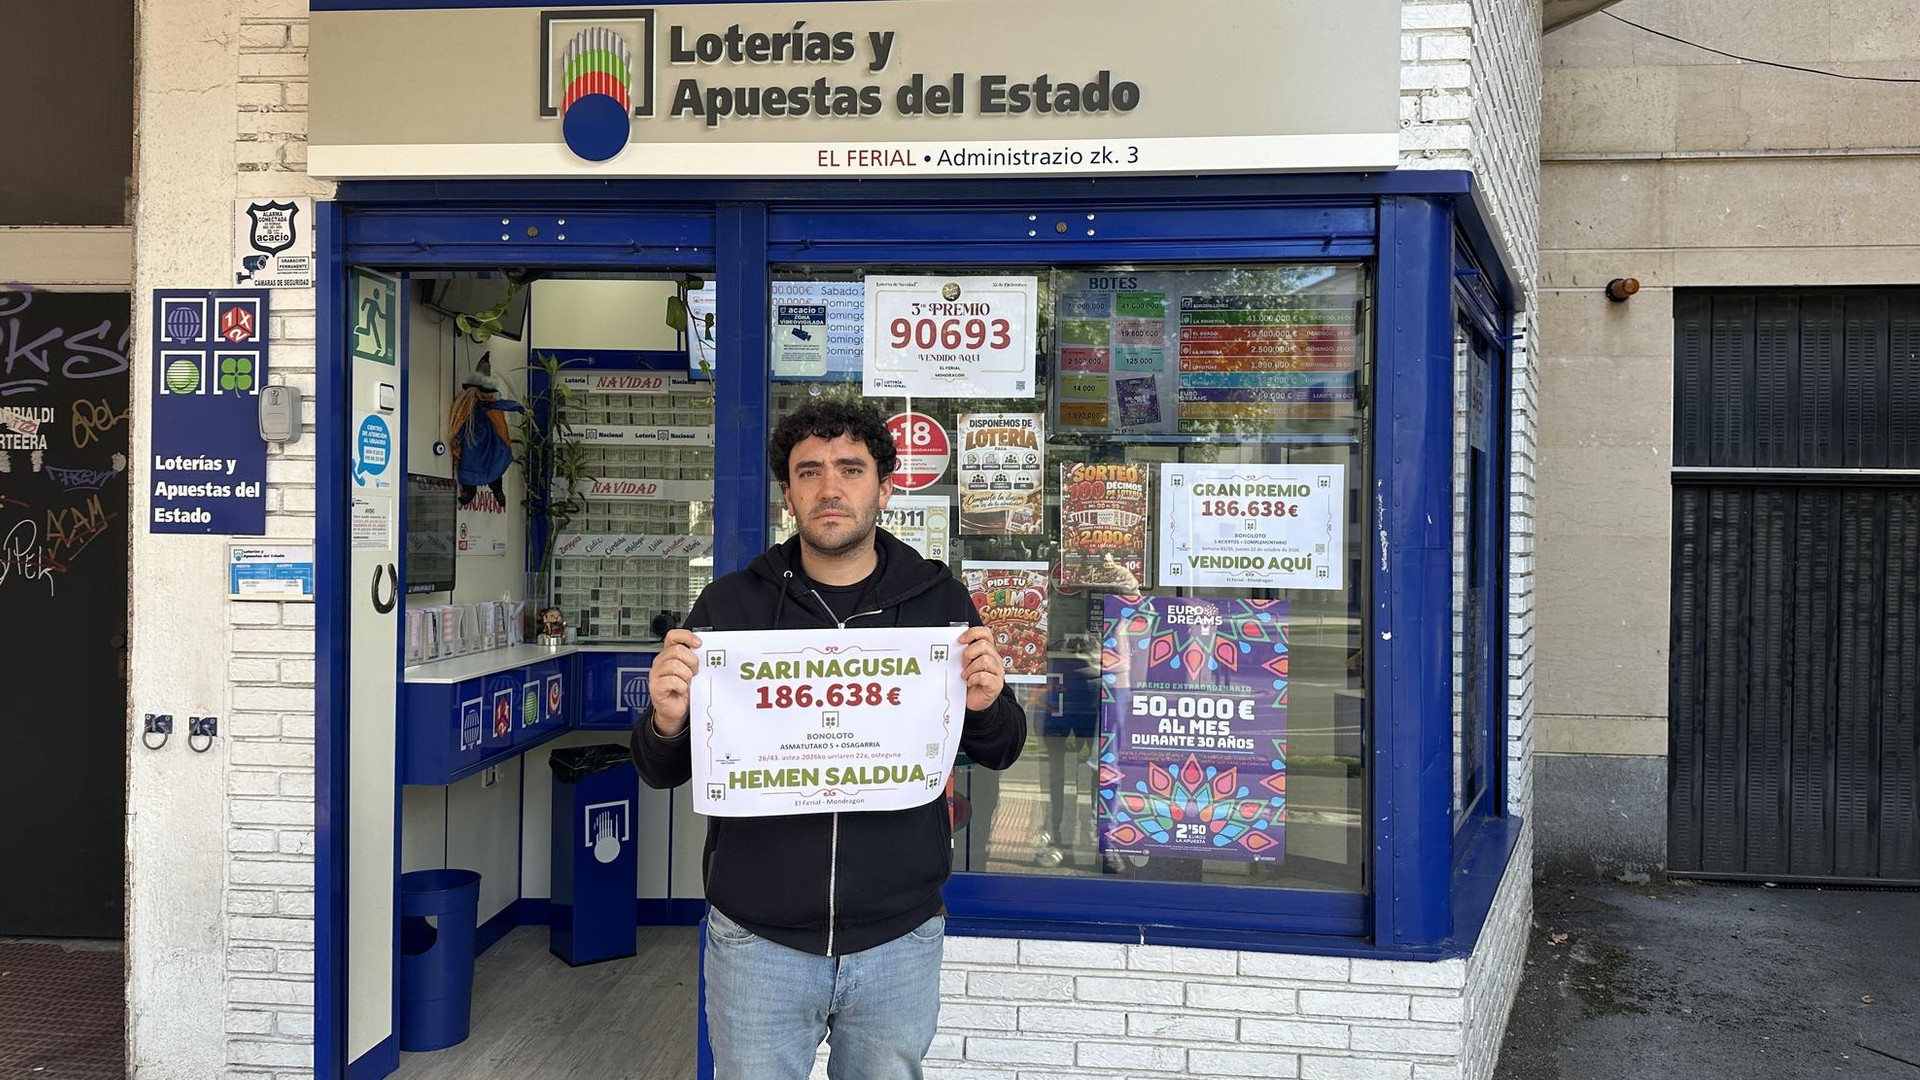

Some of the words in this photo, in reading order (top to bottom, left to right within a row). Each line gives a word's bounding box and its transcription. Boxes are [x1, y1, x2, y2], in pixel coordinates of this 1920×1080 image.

[671, 22, 854, 64] Loterías
[869, 31, 894, 71] y
[672, 79, 882, 127] Apuestas
[897, 73, 964, 115] del
[980, 71, 1140, 113] Estado
[818, 151, 839, 167] EL
[847, 150, 917, 167] FERIAL
[937, 147, 1082, 167] Administrazio
[1090, 148, 1118, 164] zk.
[1128, 147, 1139, 163] 3
[257, 232, 289, 241] acacio
[1089, 277, 1137, 289] BOTES
[821, 286, 859, 296] Sabado
[929, 303, 990, 316] PREMIO
[890, 318, 1011, 350] 90693
[918, 354, 956, 362] VENDIDO
[596, 377, 663, 389] NAVIDAD
[969, 419, 1020, 428] DISPONEMOS
[1021, 419, 1032, 428] DE
[891, 421, 931, 446] +18
[965, 427, 1039, 451] LOTERÍA
[156, 455, 222, 471] Loterías
[226, 458, 236, 474] y
[1073, 465, 1138, 482] SORTEO
[154, 482, 231, 499] Apuestas
[235, 482, 260, 498] del
[590, 482, 657, 494] NAVIDAD
[1069, 481, 1105, 500] 100
[1192, 484, 1241, 497] GRAN
[1245, 484, 1311, 498] PREMIO
[154, 508, 211, 524] Estado
[1188, 556, 1265, 570] VENDIDO
[1268, 553, 1312, 572] AQUÍ
[987, 578, 1010, 588] PIDE
[1013, 577, 1026, 587] TU
[979, 605, 1042, 624] Sorpresa
[1168, 605, 1204, 615] EURO
[1168, 615, 1222, 626] DREAMS
[740, 661, 800, 680] SARI
[806, 657, 921, 678] NAGUSIA
[1137, 682, 1170, 690] PREMIO
[1173, 683, 1252, 692] EXTRAORDINARIO
[1132, 695, 1236, 720] 50.000
[1238, 700, 1255, 720] €
[1158, 719, 1185, 734] AL
[1190, 721, 1230, 736] MES
[807, 732, 854, 740] BONOLOTO
[1132, 734, 1195, 747] DURANTE
[1197, 736, 1215, 748] 30
[1218, 735, 1255, 749] AÑOS
[780, 742, 828, 750] ASMATUTAKO
[871, 752, 902, 761] osteguna
[729, 768, 820, 789] HEMEN
[825, 764, 925, 786] SALDUA
